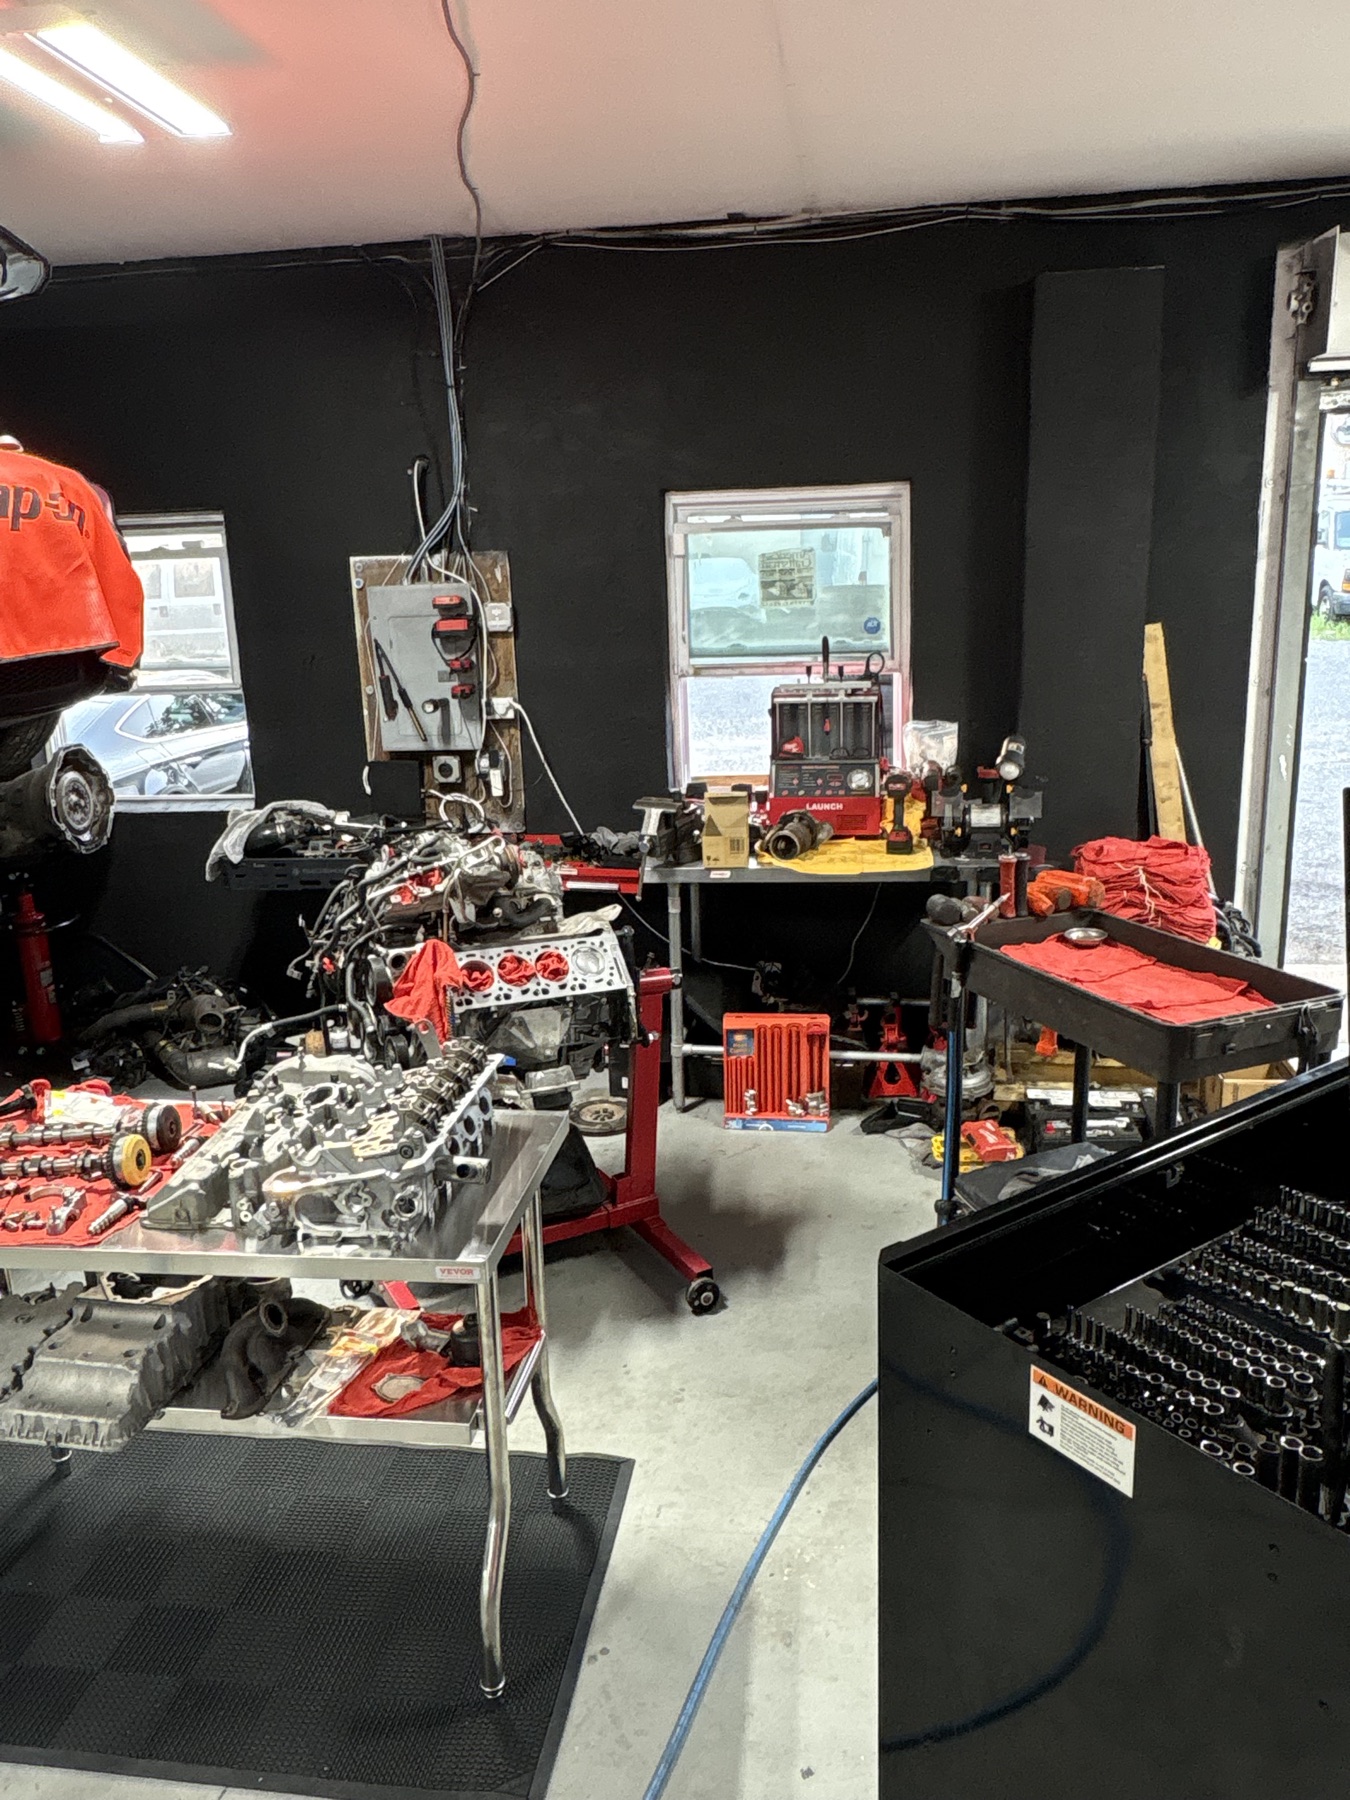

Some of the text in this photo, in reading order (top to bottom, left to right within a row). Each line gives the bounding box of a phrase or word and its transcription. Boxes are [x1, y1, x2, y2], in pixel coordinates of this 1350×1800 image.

[806, 803, 843, 811] LAUNCH
[440, 1268, 474, 1276] VEVOR
[1055, 1384, 1125, 1435] WARNING
